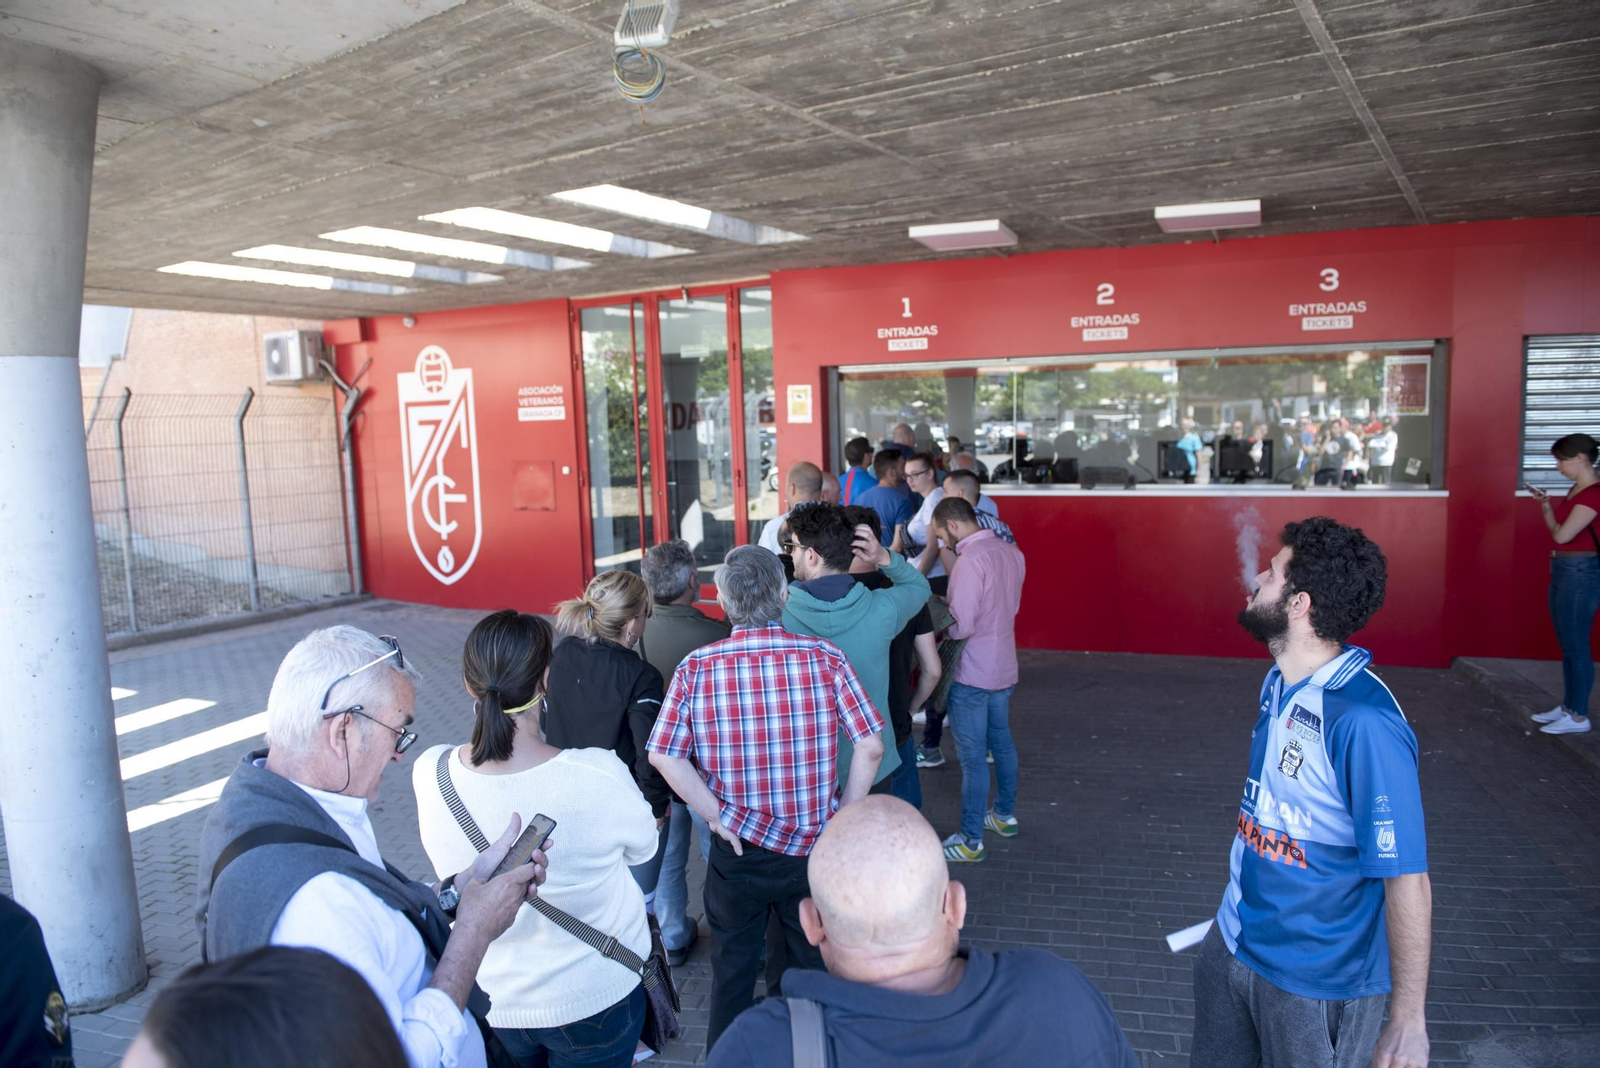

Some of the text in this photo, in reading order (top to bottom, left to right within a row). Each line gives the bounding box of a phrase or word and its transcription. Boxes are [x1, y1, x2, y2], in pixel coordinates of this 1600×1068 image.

[1319, 267, 1340, 291] 3
[1096, 282, 1115, 305] 2
[901, 297, 913, 318] 1
[1288, 300, 1367, 316] ENTRADAS
[1070, 312, 1141, 328] ENTRADAS
[1306, 318, 1350, 328] TICKETS
[877, 324, 939, 339] ENTRADAS
[1086, 329, 1125, 338] TICKETS
[891, 340, 926, 349] TICKETS
[517, 384, 563, 396] ASOCIACIÓN
[518, 396, 564, 407] VETERANOS
